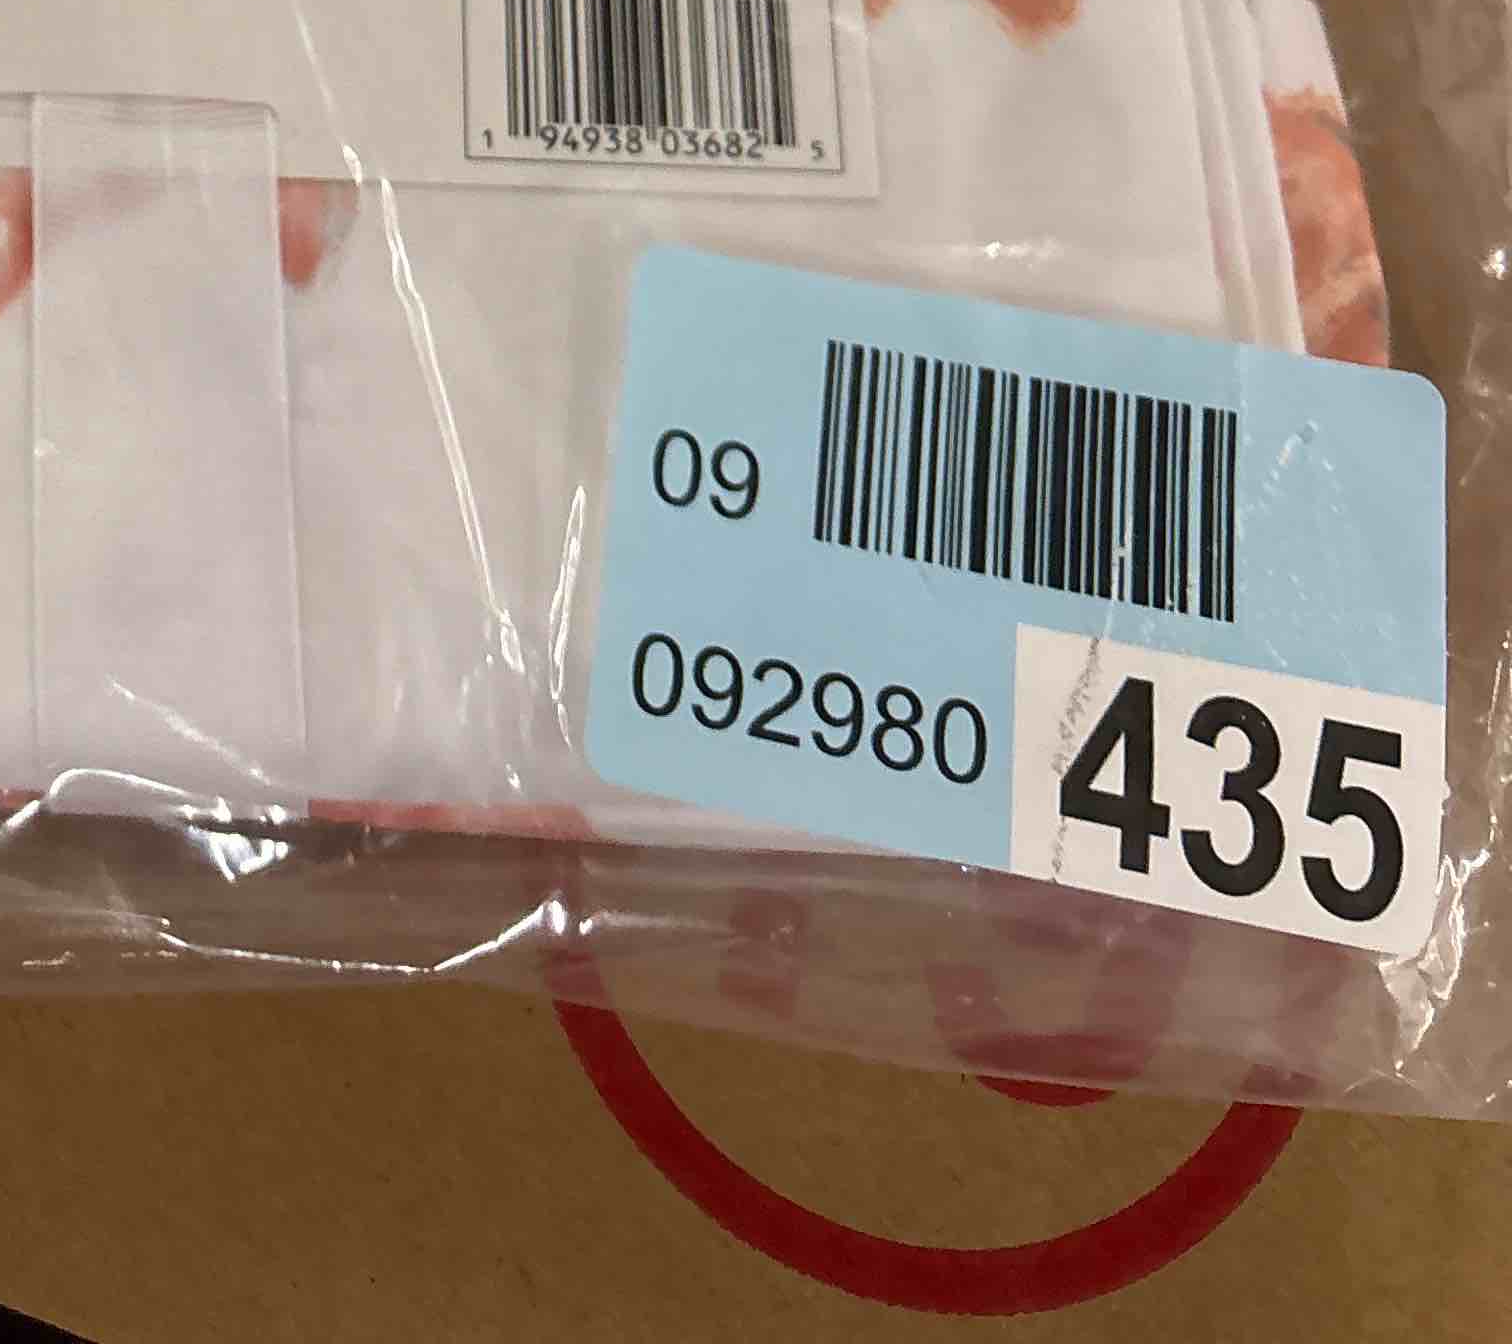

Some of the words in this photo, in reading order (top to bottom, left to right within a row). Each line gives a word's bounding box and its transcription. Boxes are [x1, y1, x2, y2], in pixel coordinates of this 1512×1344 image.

[481, 128, 493, 150] 1
[540, 124, 645, 156] 94938
[660, 128, 765, 159] 03682
[810, 140, 826, 162] 5
[652, 426, 762, 521] 09
[631, 631, 989, 785] 092980
[1058, 675, 1406, 924] 435
